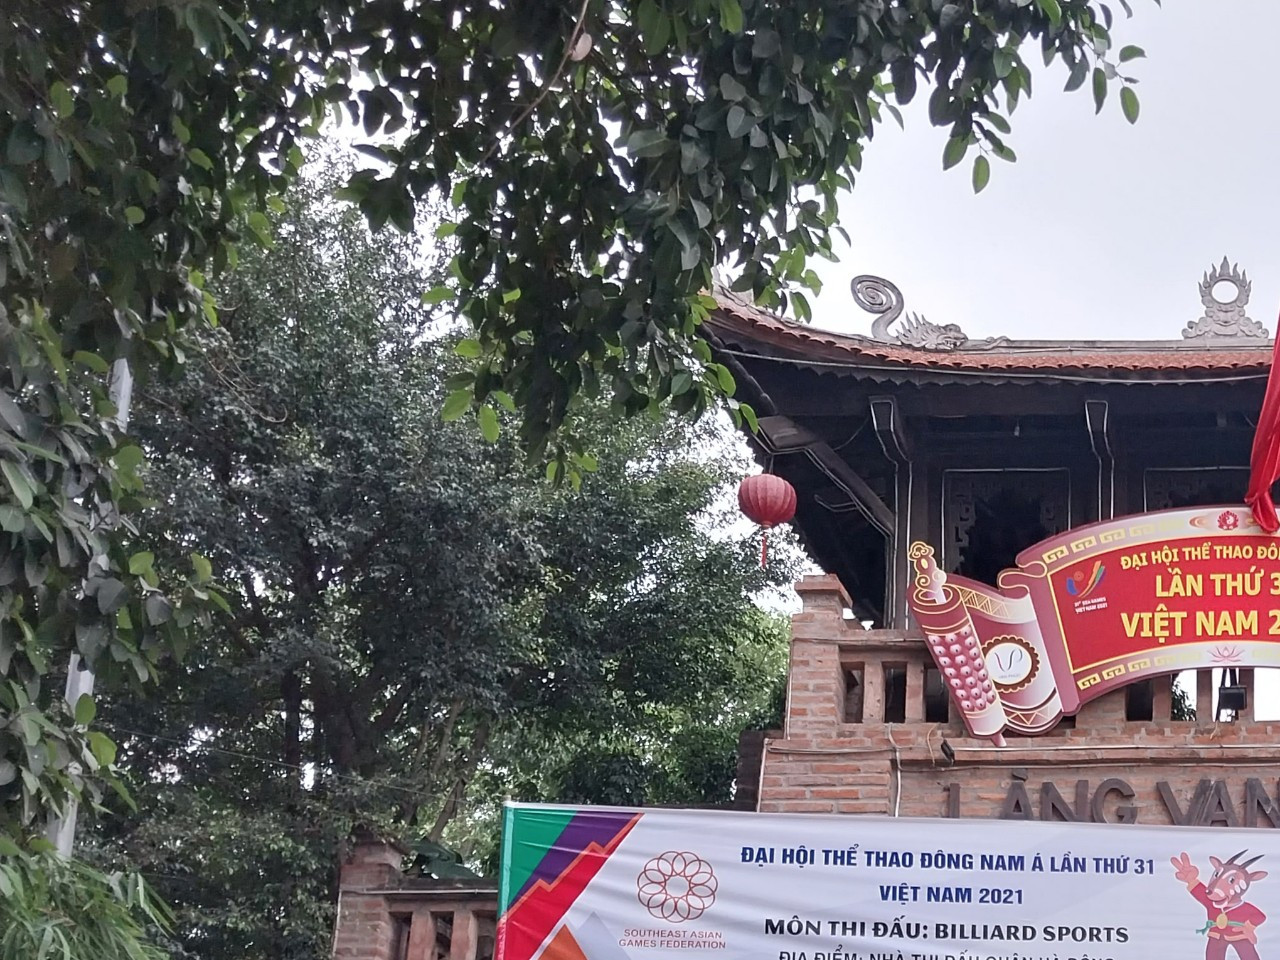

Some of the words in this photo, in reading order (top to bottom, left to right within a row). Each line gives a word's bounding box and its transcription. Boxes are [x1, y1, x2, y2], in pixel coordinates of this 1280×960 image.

[1120, 552, 1148, 570] ĐẠI
[1151, 545, 1179, 566] HỘI
[1182, 542, 1211, 561] THỂ
[1213, 545, 1253, 560] THAO
[1155, 567, 1203, 598] LẦN
[1210, 565, 1264, 597] THỨ
[1120, 604, 1187, 643] VIỆT
[1195, 610, 1258, 637] NAM
[741, 847, 774, 867] ĐẠI
[782, 845, 815, 868] HỘI
[822, 844, 859, 866] THỂ
[864, 850, 913, 868] THAO
[920, 850, 973, 870] ĐÔNG
[980, 854, 1024, 872] NAM
[1031, 853, 1044, 872] Á
[1050, 851, 1086, 873] LẦN
[1093, 855, 1130, 873] THỨ
[1134, 859, 1154, 875] 31
[879, 882, 920, 905] VIỆT
[927, 886, 972, 903] NAM
[979, 888, 1023, 904] 2021
[624, 929, 687, 938] SOUTHEAST
[690, 930, 722, 939] ASIAN
[765, 915, 821, 936] MÔN
[828, 921, 866, 937] THI
[872, 915, 928, 939] ĐẤU:
[935, 923, 1037, 941] BILLIARD
[1043, 925, 1129, 943] SPORTS
[619, 939, 657, 948] GAMES
[660, 940, 726, 949] FEDERATION
